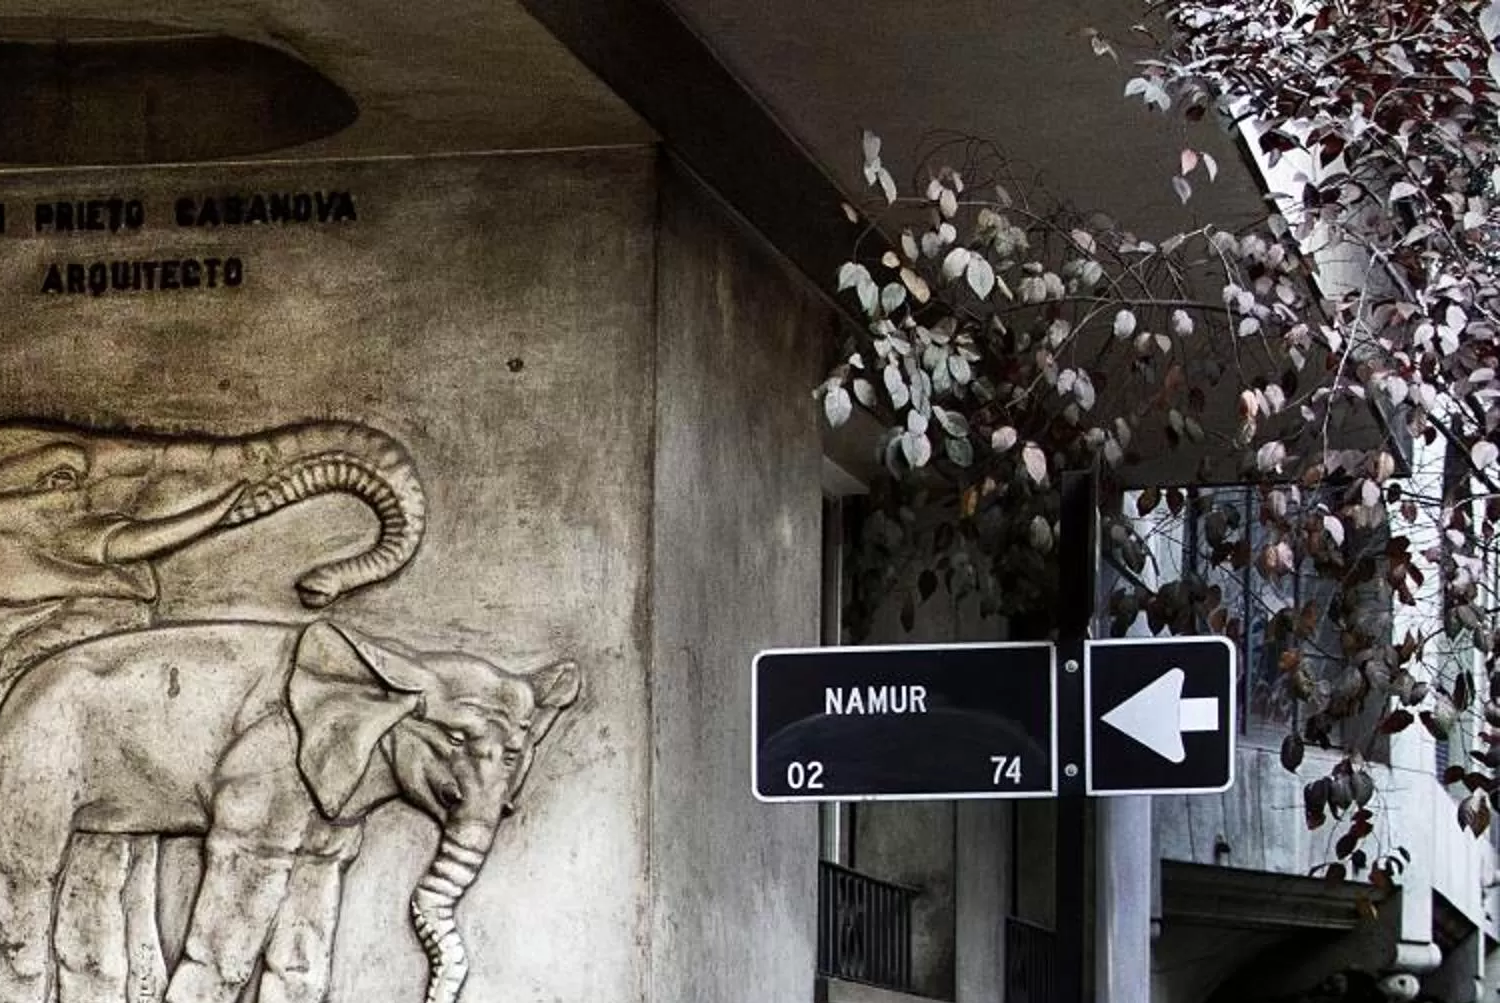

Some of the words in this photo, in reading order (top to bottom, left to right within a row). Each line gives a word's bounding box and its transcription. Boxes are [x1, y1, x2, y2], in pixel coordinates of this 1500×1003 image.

[35, 198, 145, 234] PRIETO
[40, 257, 244, 297] ARQUITECTO
[824, 685, 928, 716] NAMUR
[786, 760, 825, 790] 02
[989, 756, 1023, 785] 74
